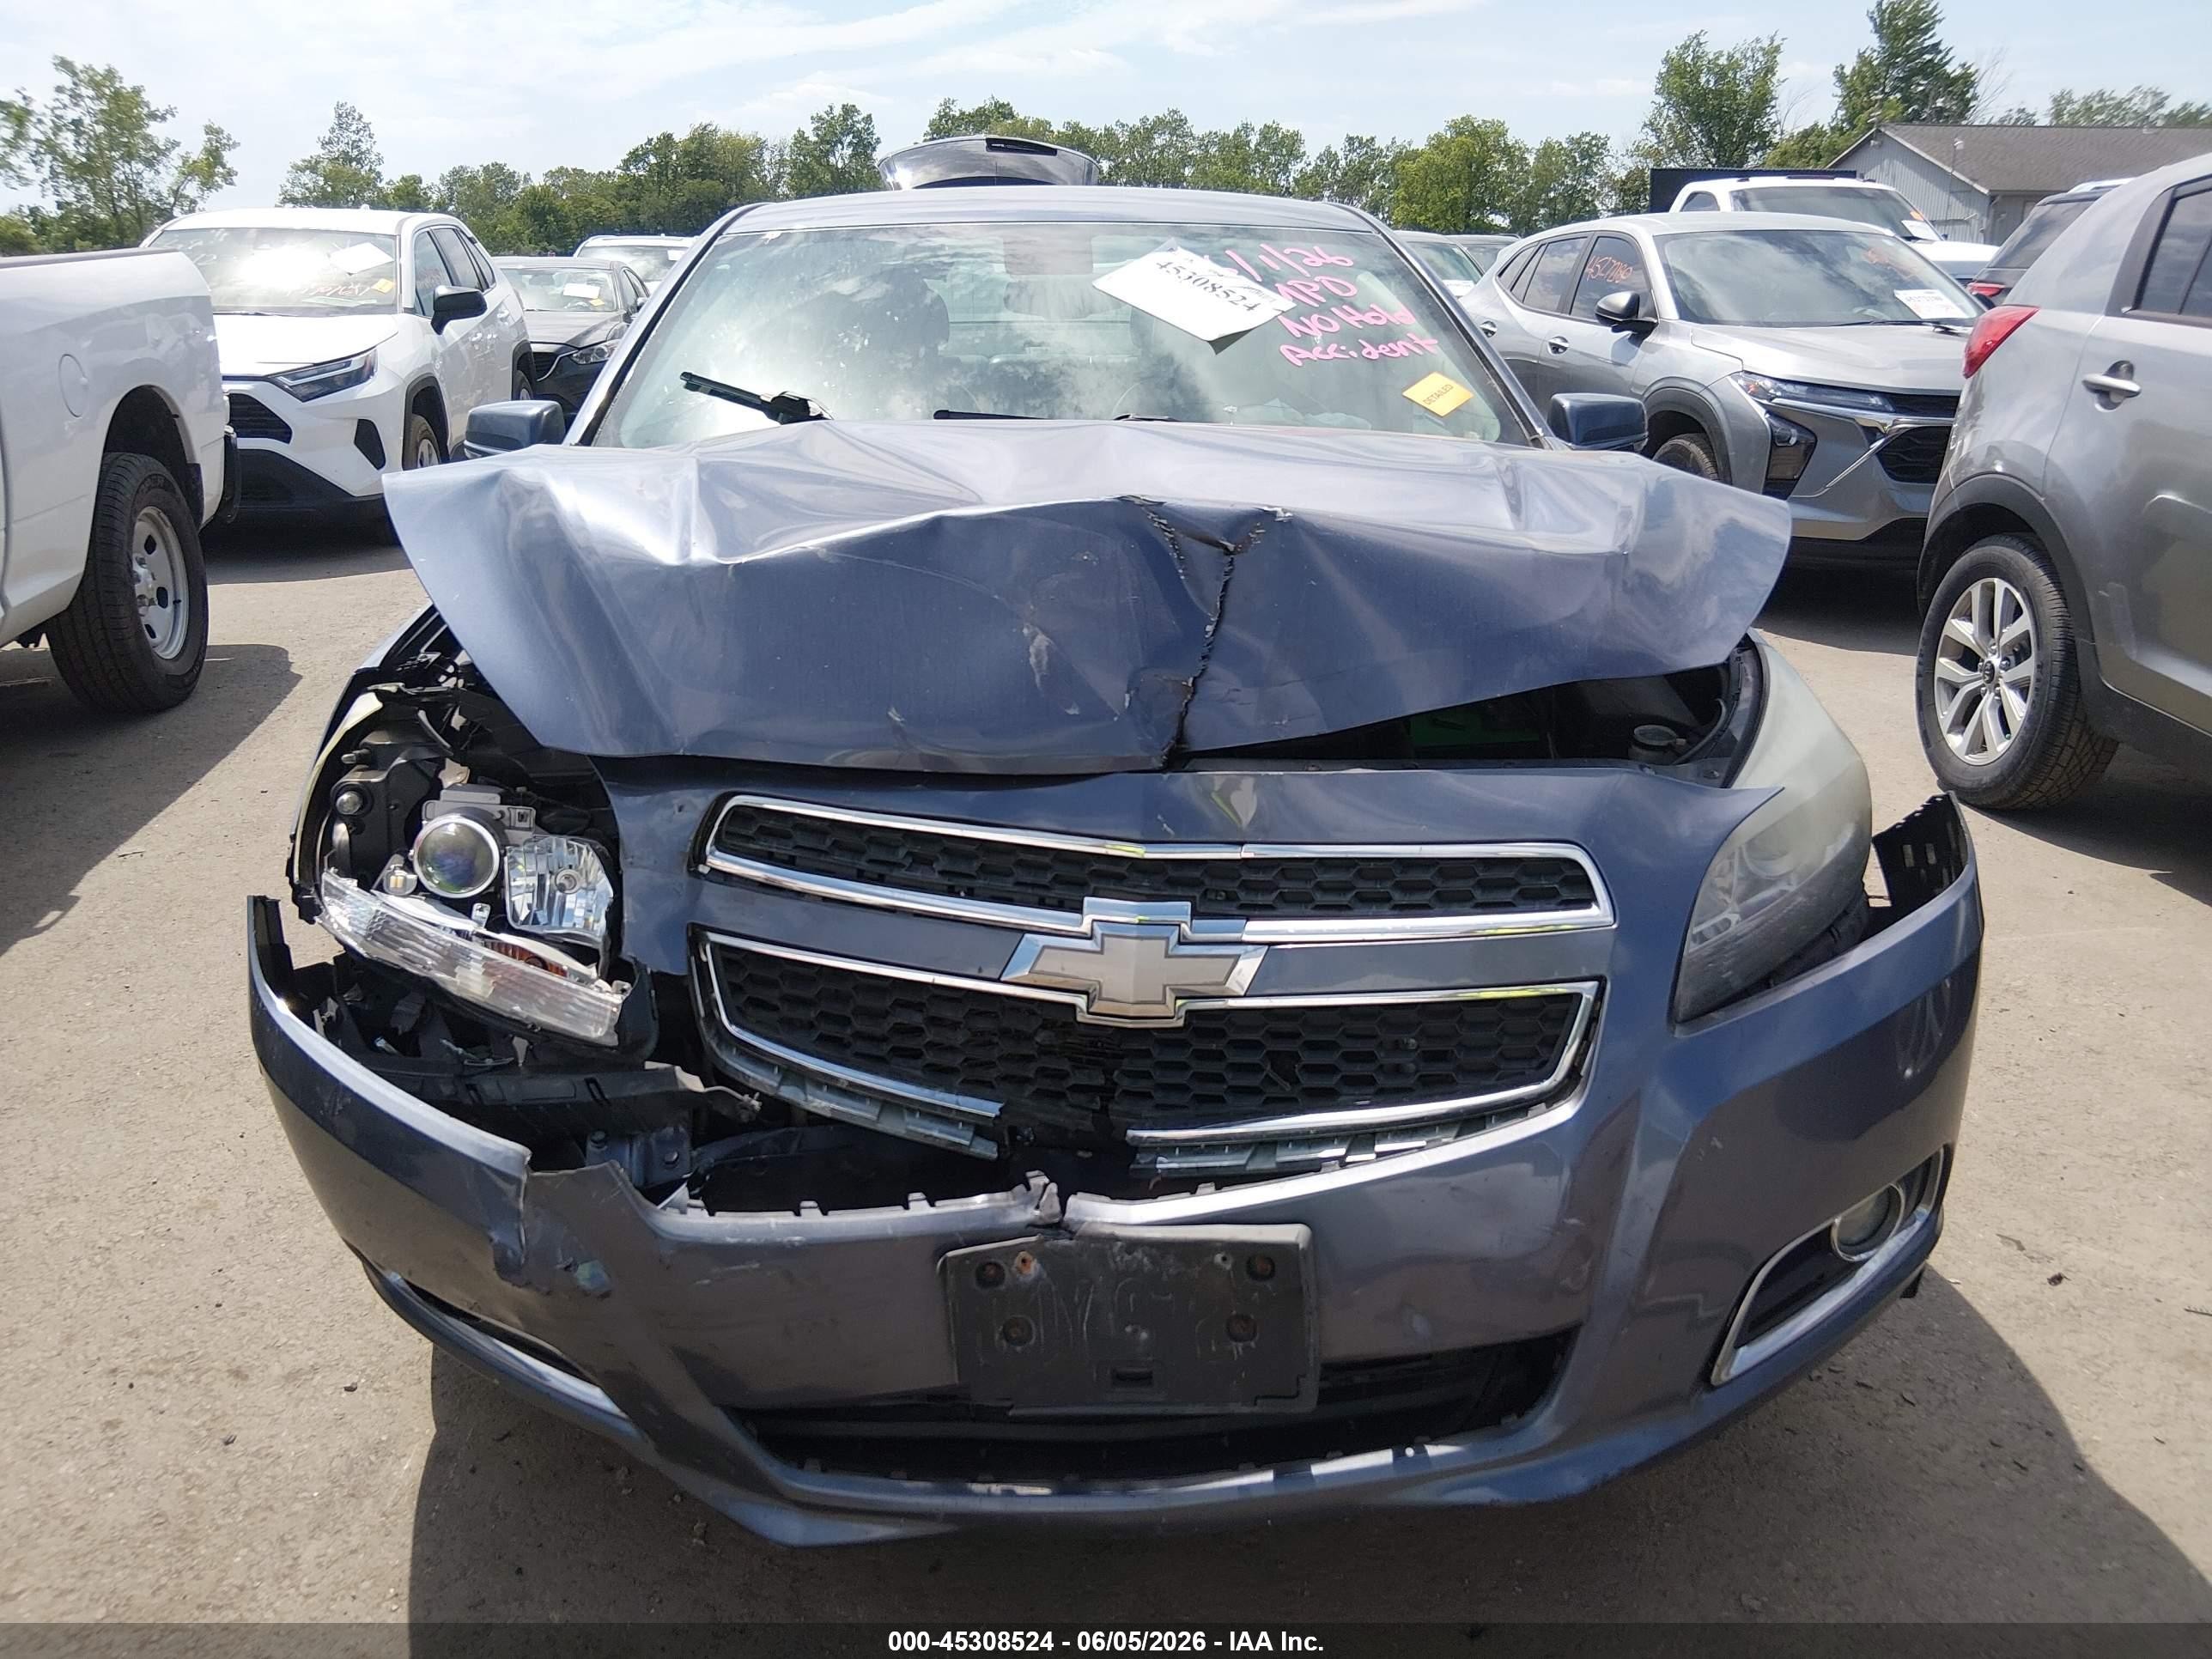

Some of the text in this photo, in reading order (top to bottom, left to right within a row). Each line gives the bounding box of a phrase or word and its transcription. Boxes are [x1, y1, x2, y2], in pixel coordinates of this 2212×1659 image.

[1222, 244, 1354, 282] /1/26
[1156, 261, 1261, 312] 45308524
[1279, 332, 1439, 368] Accident
